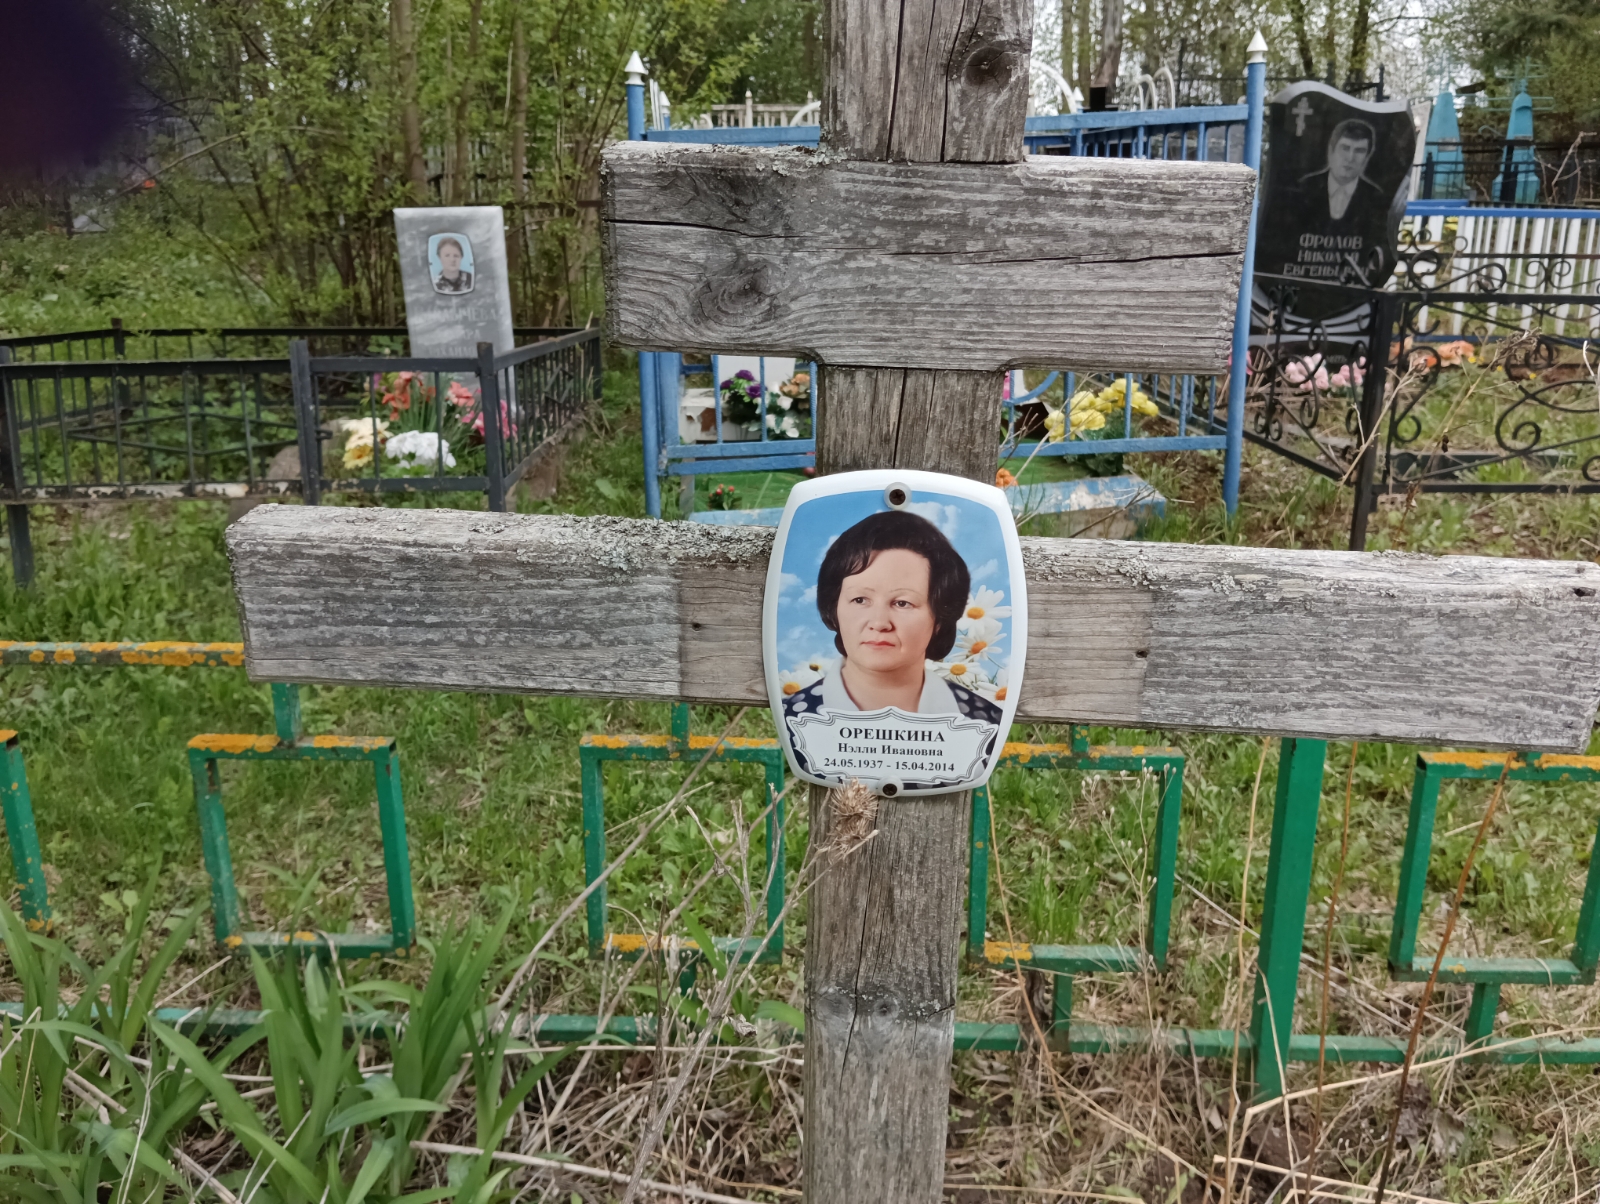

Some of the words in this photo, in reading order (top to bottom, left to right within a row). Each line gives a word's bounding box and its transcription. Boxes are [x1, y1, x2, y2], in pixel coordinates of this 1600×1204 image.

[1299, 233, 1364, 249] ФРОЛОВ
[1283, 263, 1370, 277] ЕВГЕНЬВЧ
[839, 726, 945, 742] ОРЕШКИНА
[837, 743, 877, 755] Нэлли
[881, 745, 944, 756] Ивановна
[824, 757, 883, 769] 24.05.1937
[895, 761, 955, 772] 15.04.2014
